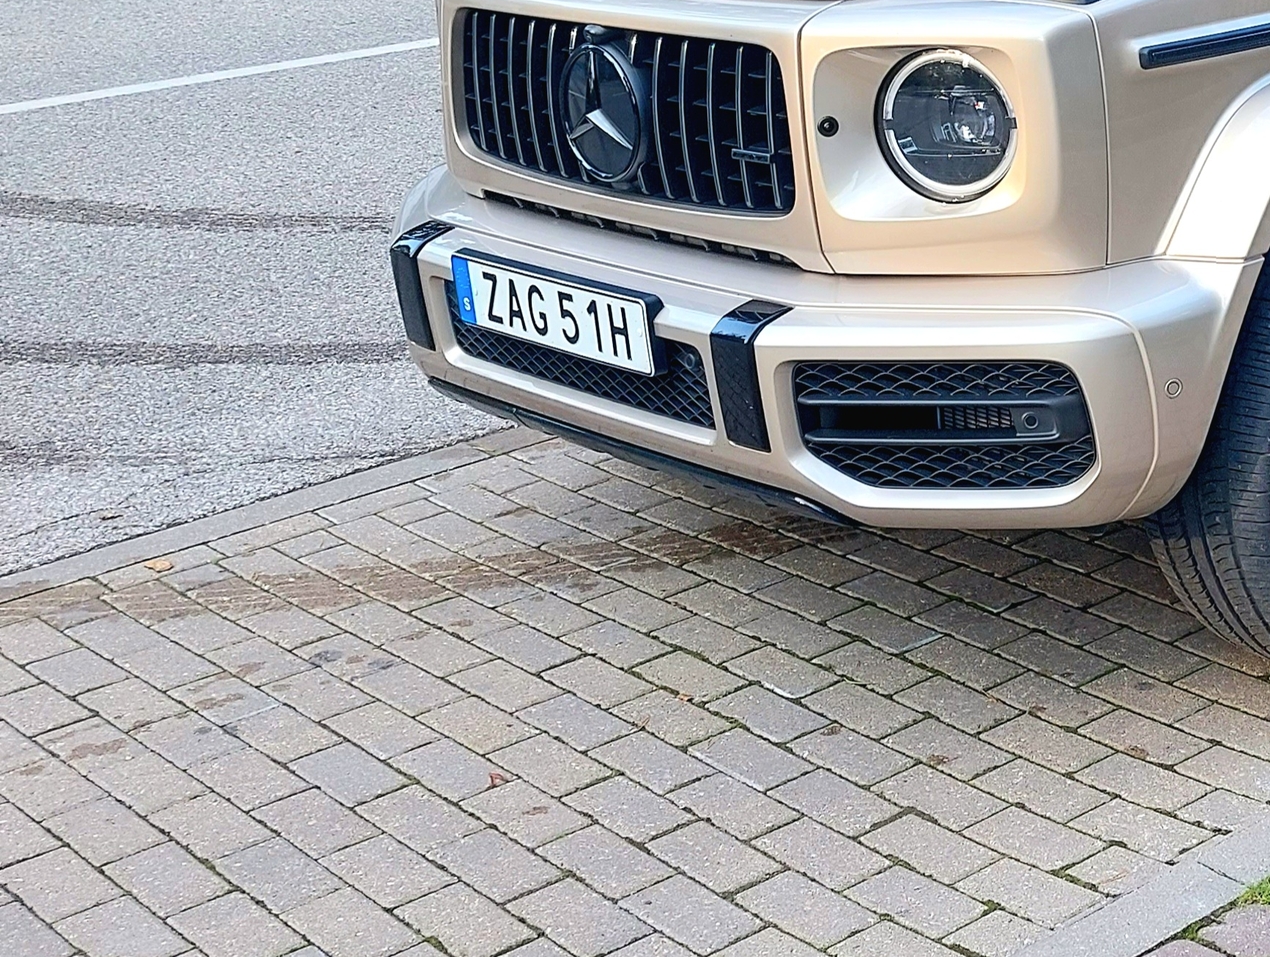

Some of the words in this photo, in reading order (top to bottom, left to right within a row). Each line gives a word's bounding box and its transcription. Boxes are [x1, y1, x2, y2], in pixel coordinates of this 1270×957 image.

[463, 297, 471, 311] S
[482, 271, 548, 337] ZAG
[557, 291, 632, 361] 51H
